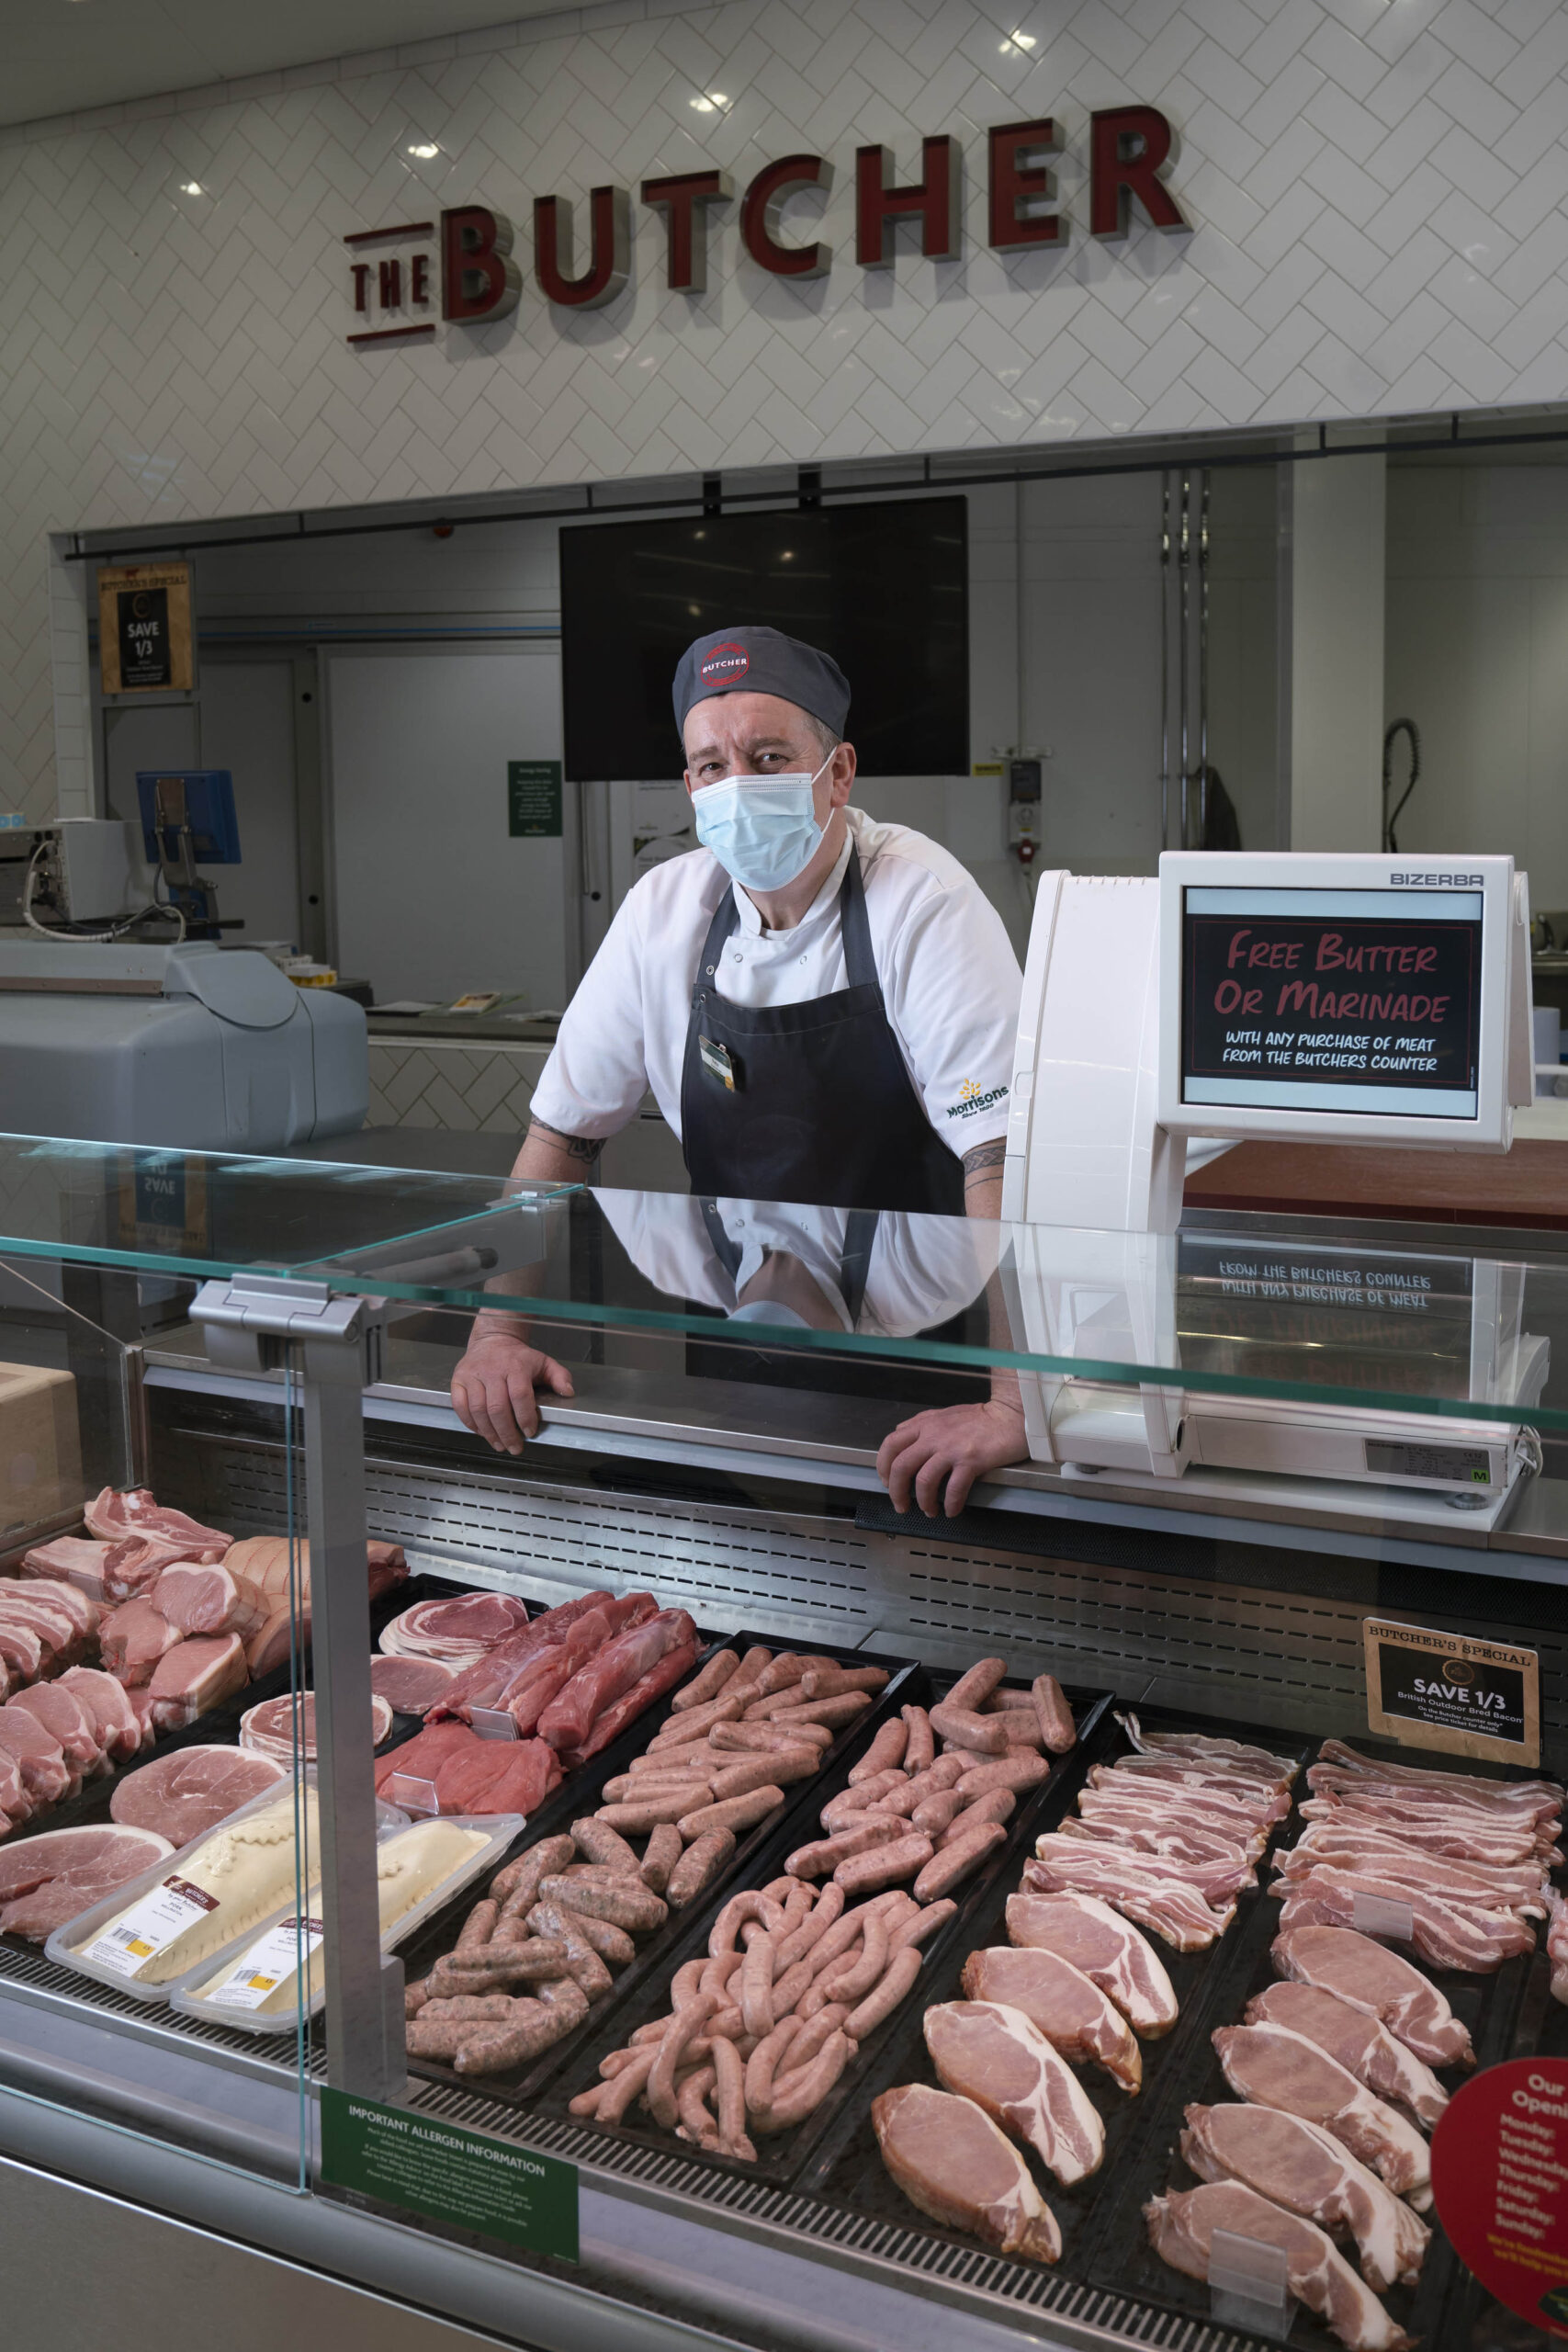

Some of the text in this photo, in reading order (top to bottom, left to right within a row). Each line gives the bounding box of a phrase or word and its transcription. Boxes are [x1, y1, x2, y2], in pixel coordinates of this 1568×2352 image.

[348, 104, 1195, 325] THE BUTCHER
[128, 621, 160, 639] SAVE
[135, 640, 153, 659] 1/3
[703, 657, 748, 673] BUTCHER
[1390, 873, 1484, 887] BIZERBA
[1226, 929, 1438, 974] FREE BUTTER
[1213, 978, 1451, 1023] OR MARINADE
[1225, 1030, 1436, 1053] WITH ANY PURCHASE OF MEAT
[1222, 1047, 1438, 1072] FROM THE BUTCHERS COUNTER
[946, 1086, 1010, 1119] Morrisons
[1473, 1471, 1487, 1481] M
[1368, 1625, 1531, 1668] BUTCHER'S SPECIAL
[1397, 1690, 1427, 1704] British
[1427, 1699, 1467, 1713] Outdoor
[1469, 1707, 1492, 1718] Bred
[1413, 1678, 1506, 1710] SAVE 1/3
[1417, 1704, 1428, 1713] On
[1427, 1706, 1438, 1715] the
[1528, 2073, 1565, 2096] Our
[348, 2104, 410, 2133] IMPORTANT
[411, 2124, 465, 2152] ALLERGEN
[466, 2142, 546, 2177] INFORMATION
